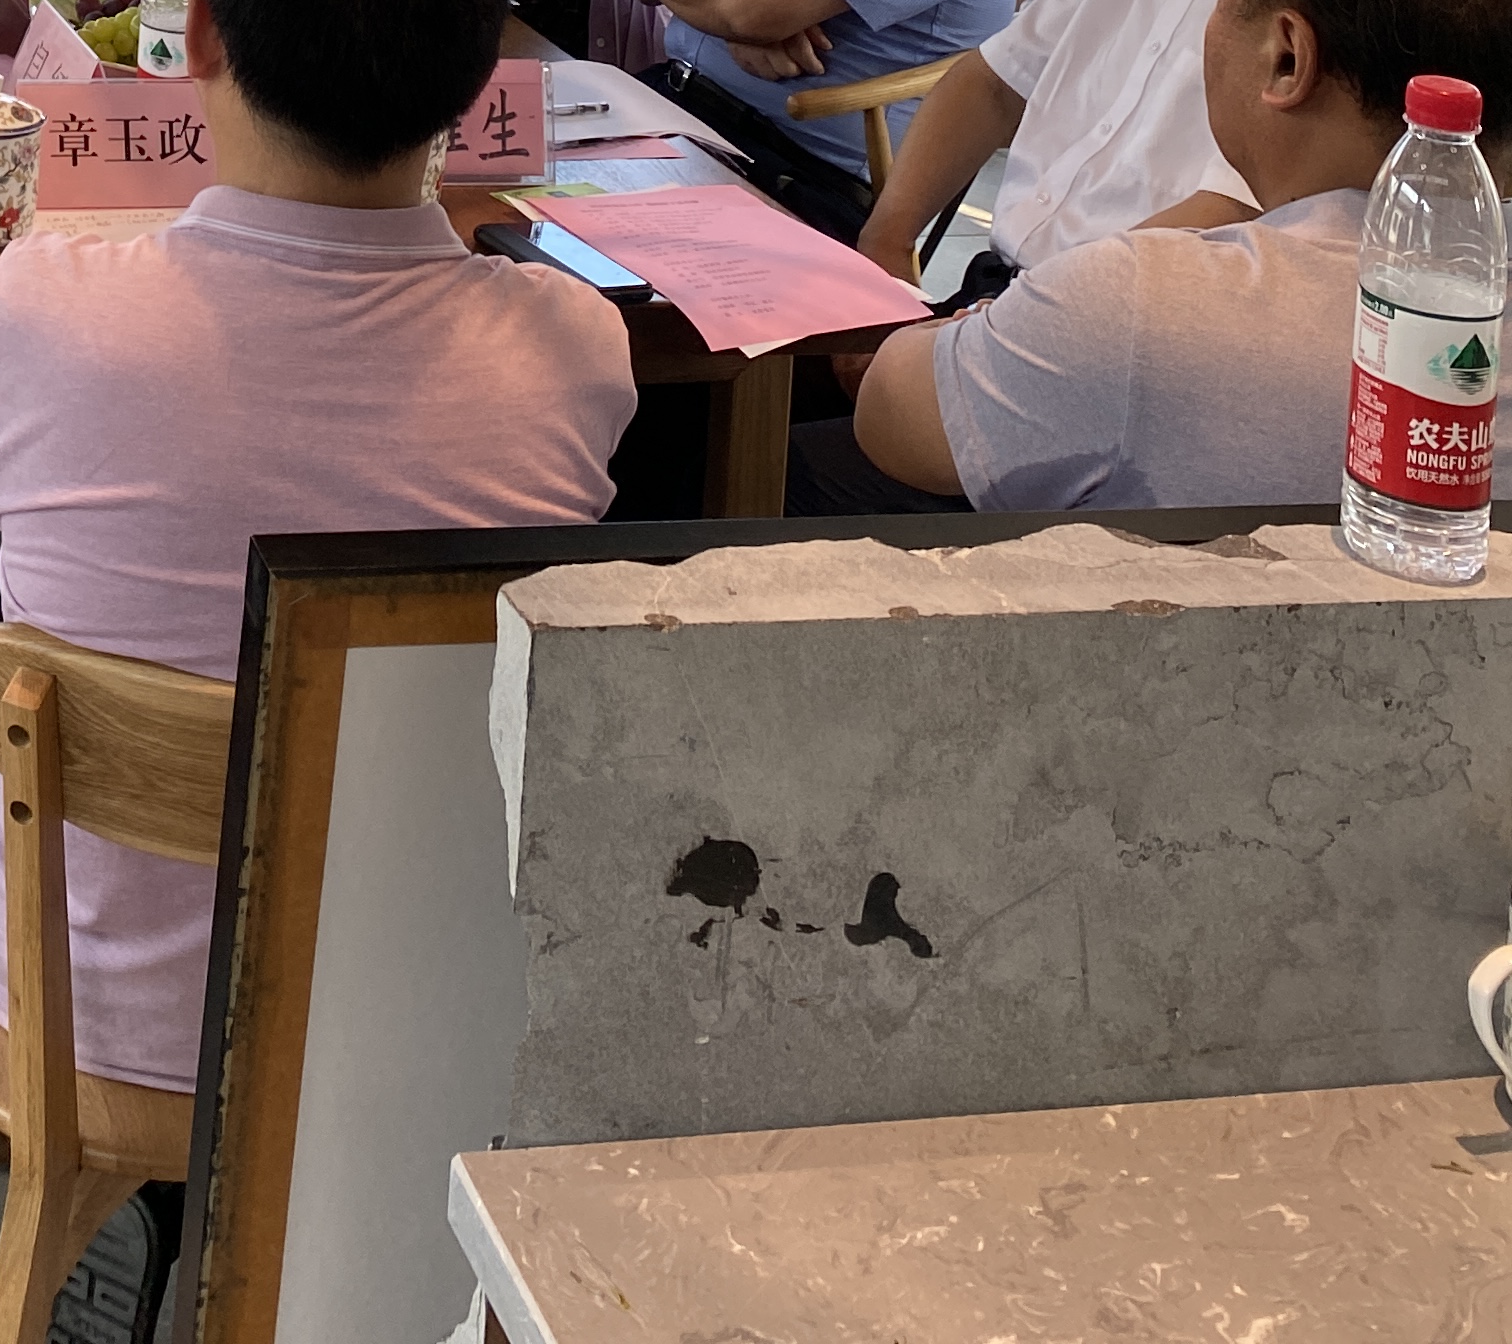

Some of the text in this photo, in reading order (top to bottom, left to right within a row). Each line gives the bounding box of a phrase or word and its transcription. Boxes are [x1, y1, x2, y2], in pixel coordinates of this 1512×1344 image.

[48, 113, 208, 167] 章玉政
[1406, 448, 1467, 471] NONGFU
[1406, 466, 1460, 486] 饮用天然水
